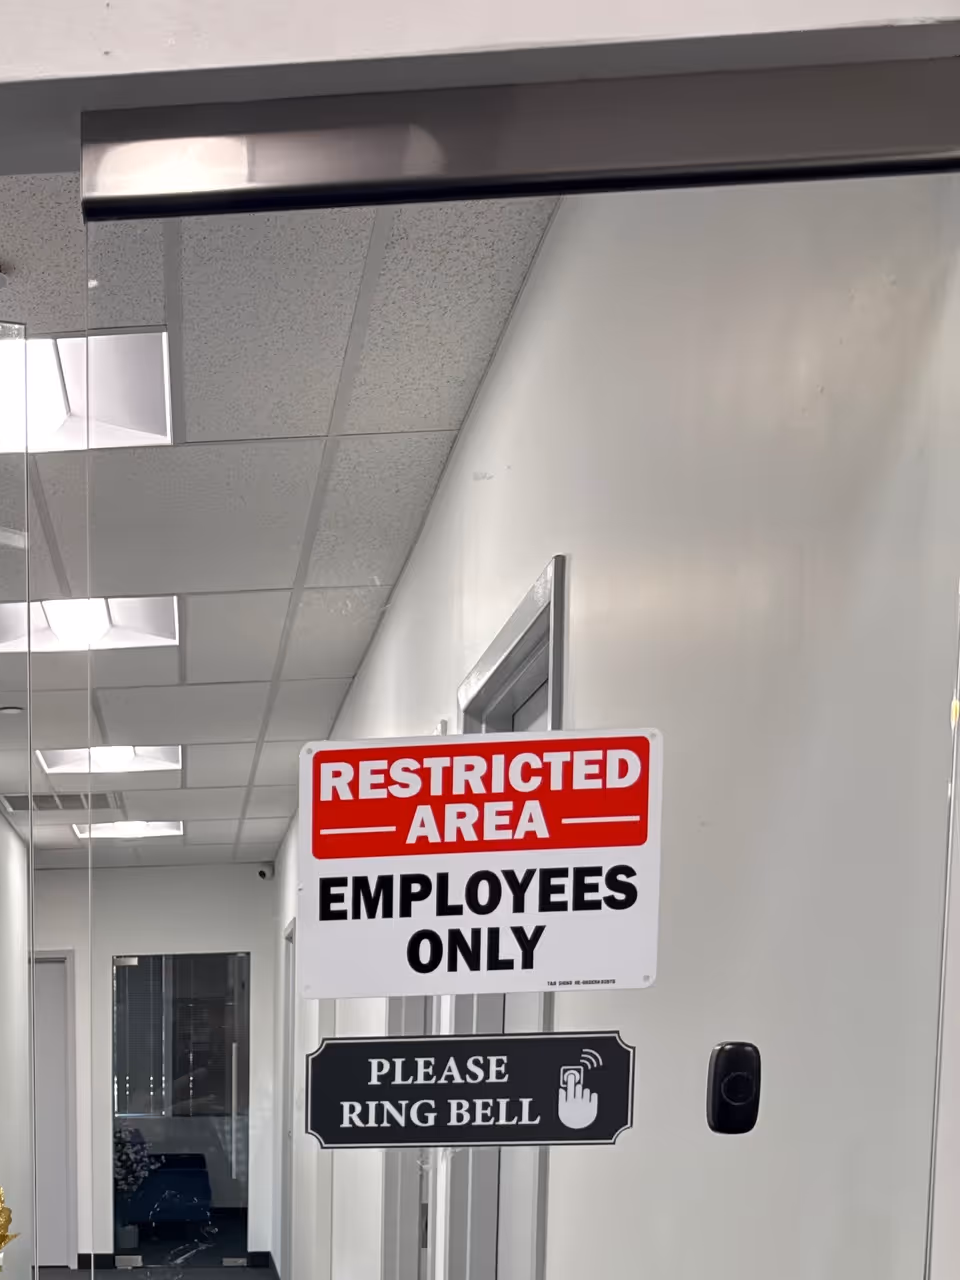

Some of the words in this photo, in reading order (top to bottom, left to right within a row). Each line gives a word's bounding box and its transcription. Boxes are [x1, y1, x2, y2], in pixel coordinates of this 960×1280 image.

[320, 749, 642, 801] RESTRICTED
[406, 800, 550, 844] AREA
[319, 864, 638, 921] EMPLOYEES
[406, 925, 547, 974] ONLY
[367, 1055, 510, 1086] PLEASE
[339, 1100, 438, 1129] RING
[446, 1097, 541, 1126] BELL
